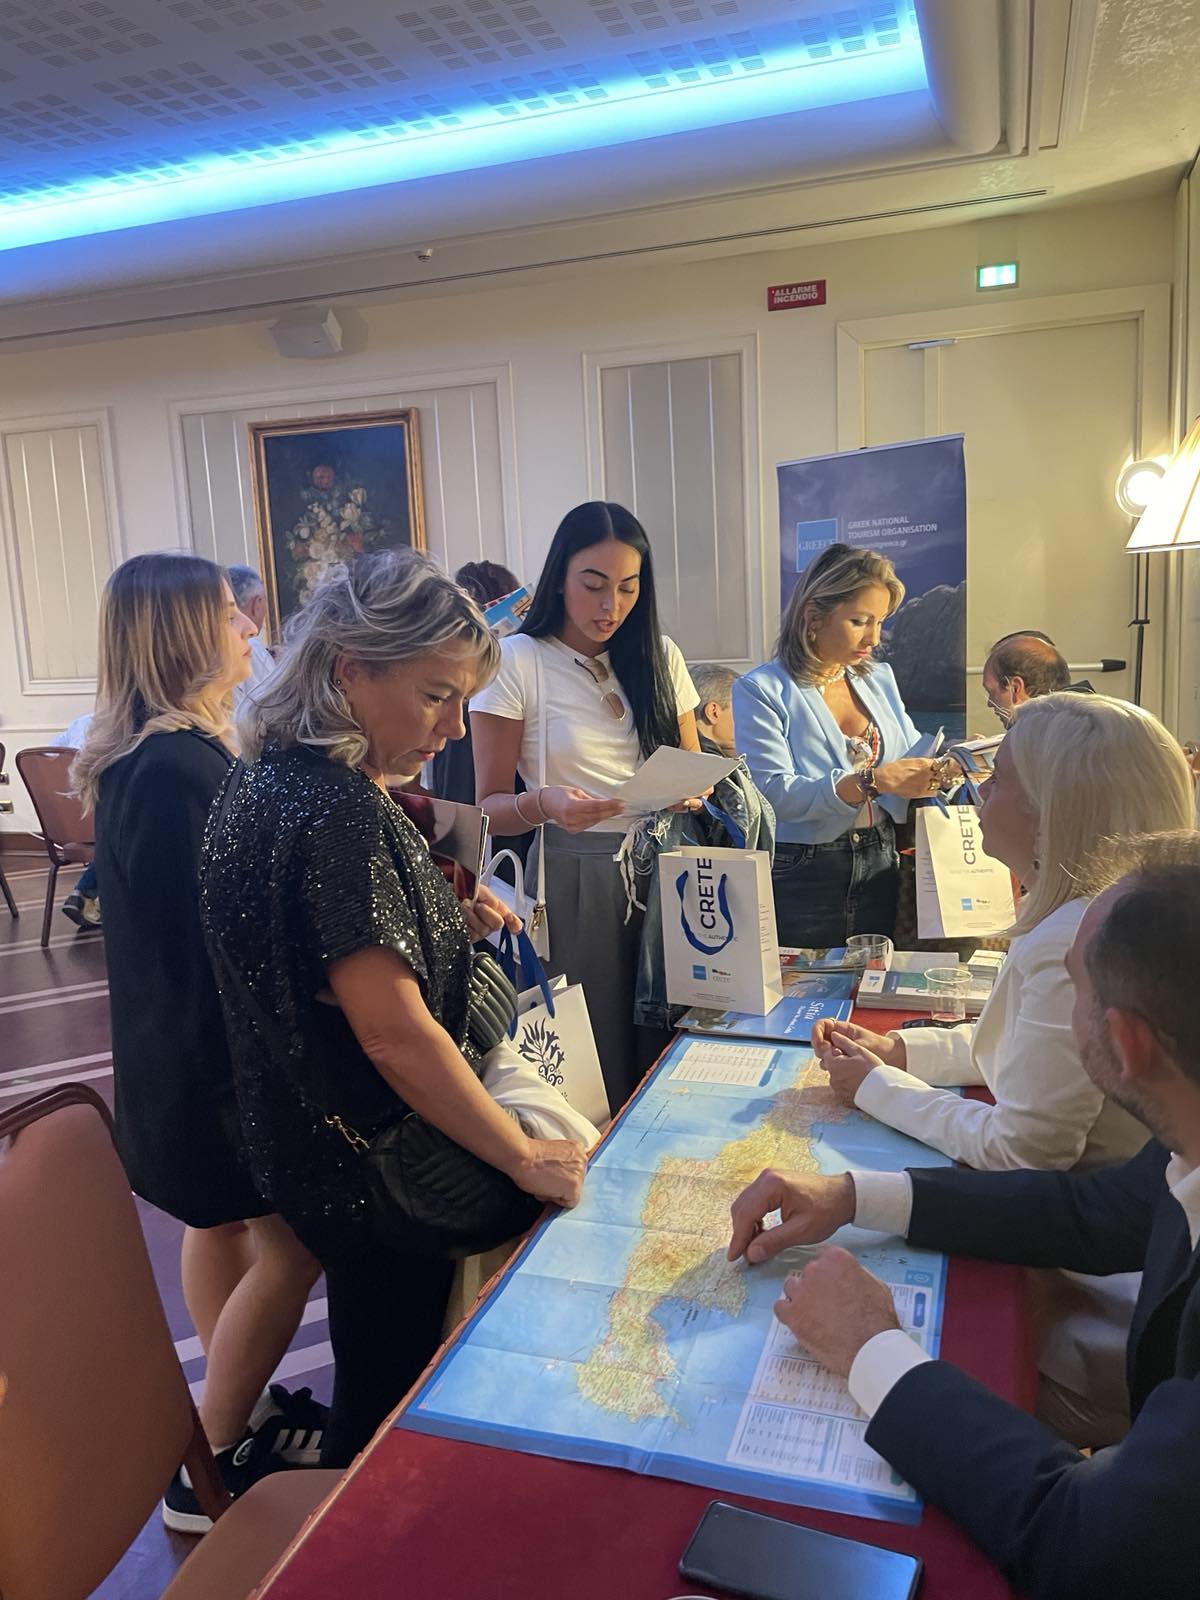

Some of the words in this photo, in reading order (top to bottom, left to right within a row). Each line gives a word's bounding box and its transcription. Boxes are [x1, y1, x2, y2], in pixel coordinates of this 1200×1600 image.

[773, 292, 818, 304] INCENDIO
[774, 285, 817, 297] ALLARME
[847, 520, 871, 530] GREEK
[871, 516, 910, 527] NATIONAL
[847, 529, 881, 540] TOURISM
[881, 523, 938, 537] ORGANISATION
[958, 805, 976, 865] CRETE
[696, 857, 716, 930] CRETE
